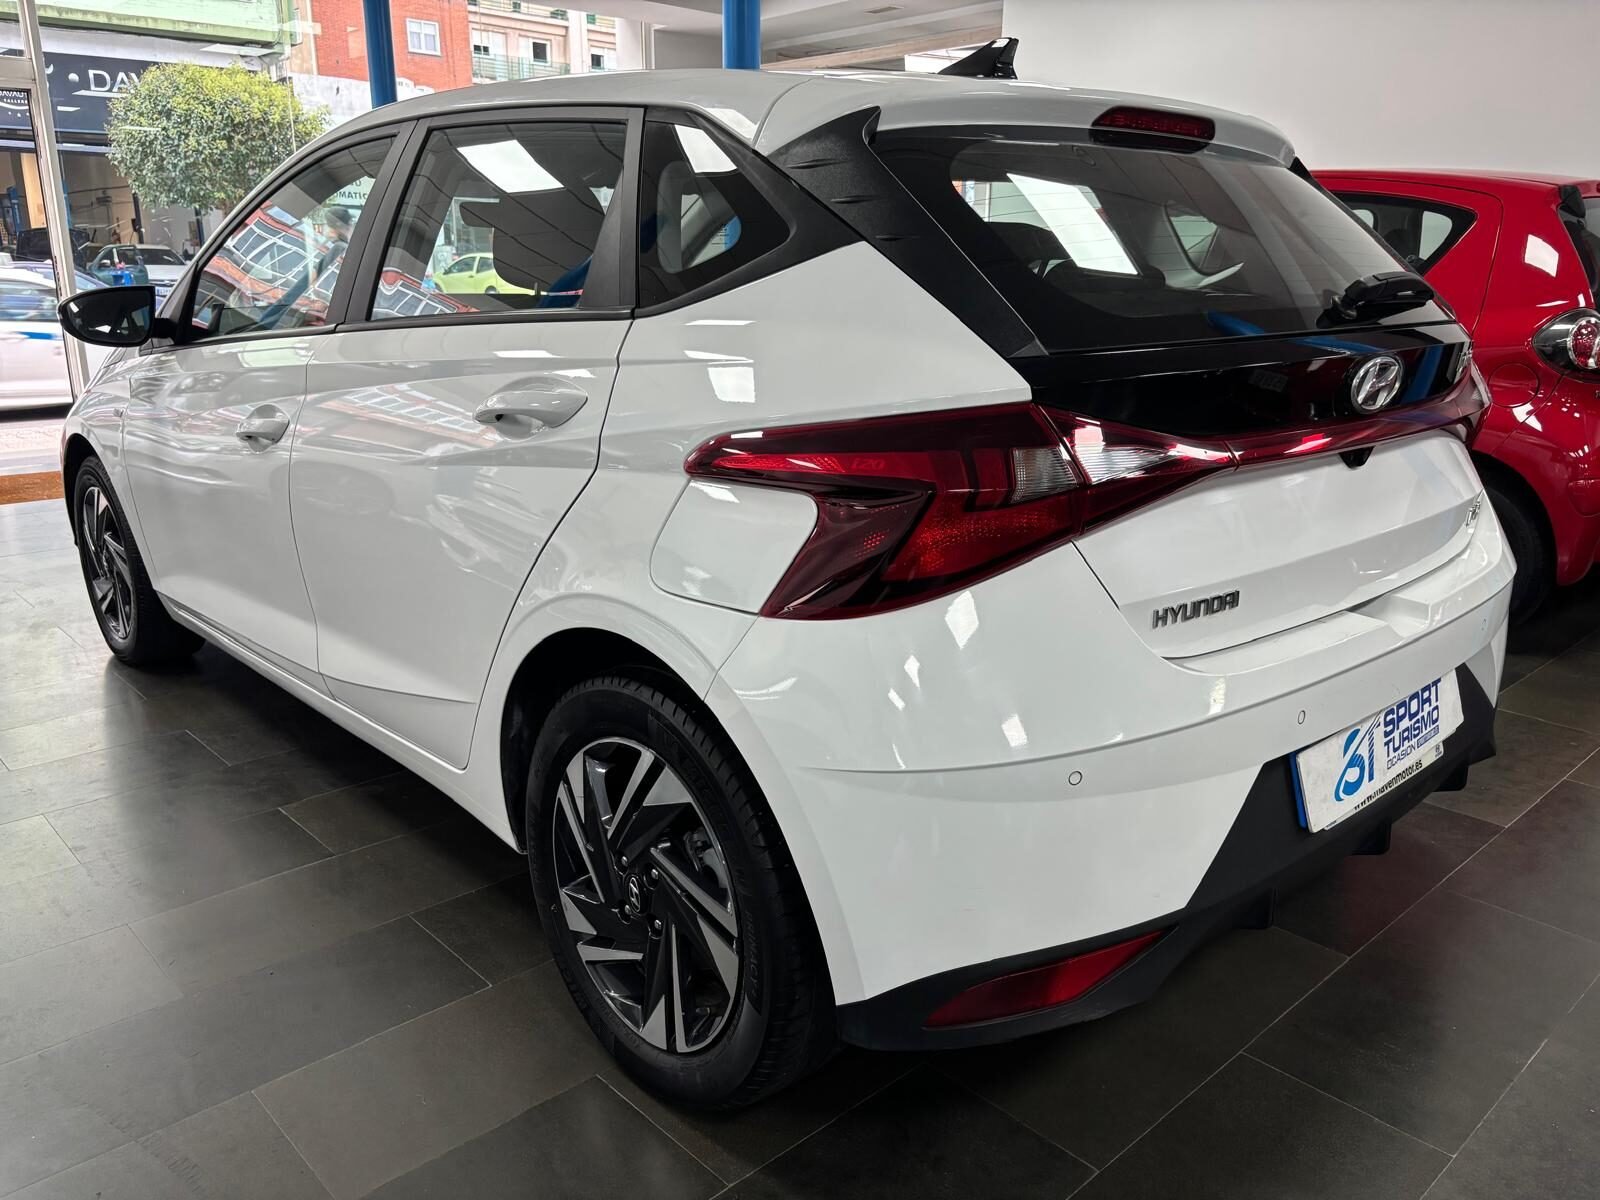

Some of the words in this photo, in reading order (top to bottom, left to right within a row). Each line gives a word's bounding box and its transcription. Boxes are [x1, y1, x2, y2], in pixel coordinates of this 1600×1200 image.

[1152, 590, 1240, 629] HYUNDAI
[1383, 677, 1441, 739] SPORT
[1383, 704, 1439, 758] TURISMO
